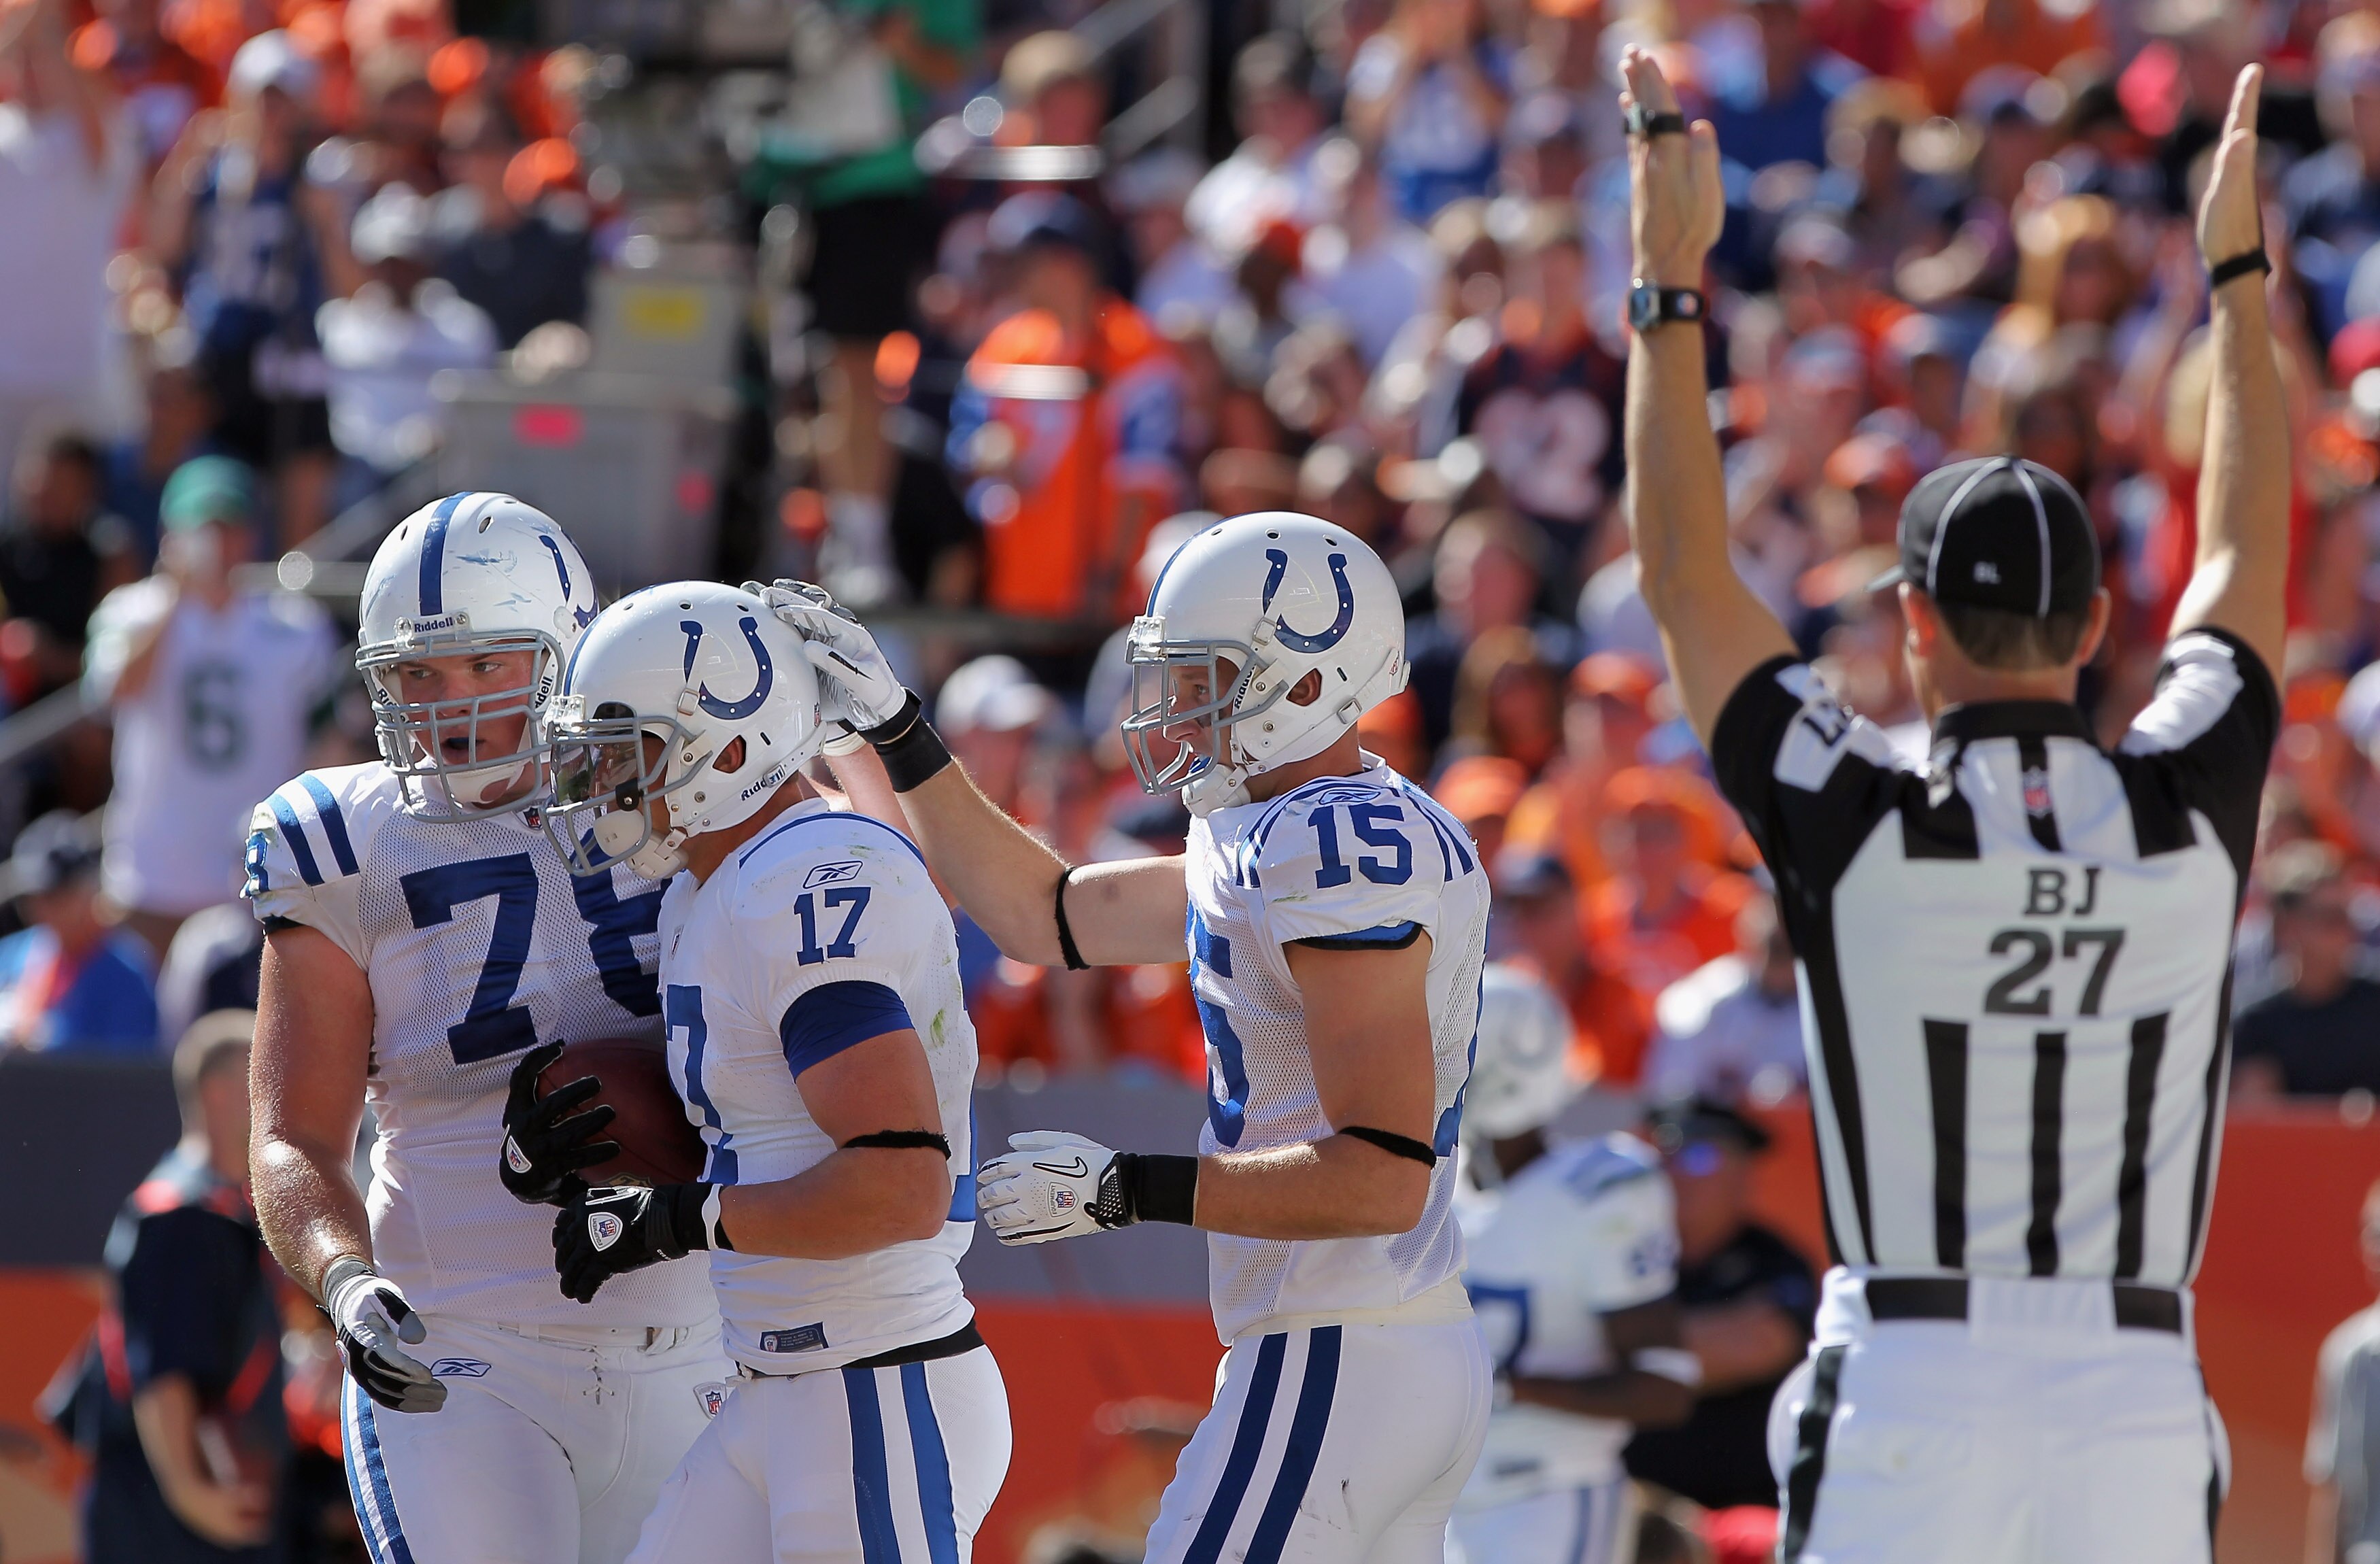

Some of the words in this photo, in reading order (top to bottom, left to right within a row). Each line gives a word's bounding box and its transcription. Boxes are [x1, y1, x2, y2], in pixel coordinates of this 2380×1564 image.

[414, 617, 453, 632] Riddell
[180, 656, 252, 775] 6
[239, 832, 269, 896] 8
[1307, 802, 1413, 889] 15
[794, 887, 871, 966] 17
[2023, 868, 2101, 915] BJ
[399, 852, 663, 1066] 78
[1985, 930, 2125, 1015] 27
[1185, 900, 1249, 1148] 5
[658, 985, 738, 1185] 7
[605, 1221, 615, 1236] NFL
[1064, 1192, 1073, 1206] NFL
[1469, 1284, 1530, 1371] 7
